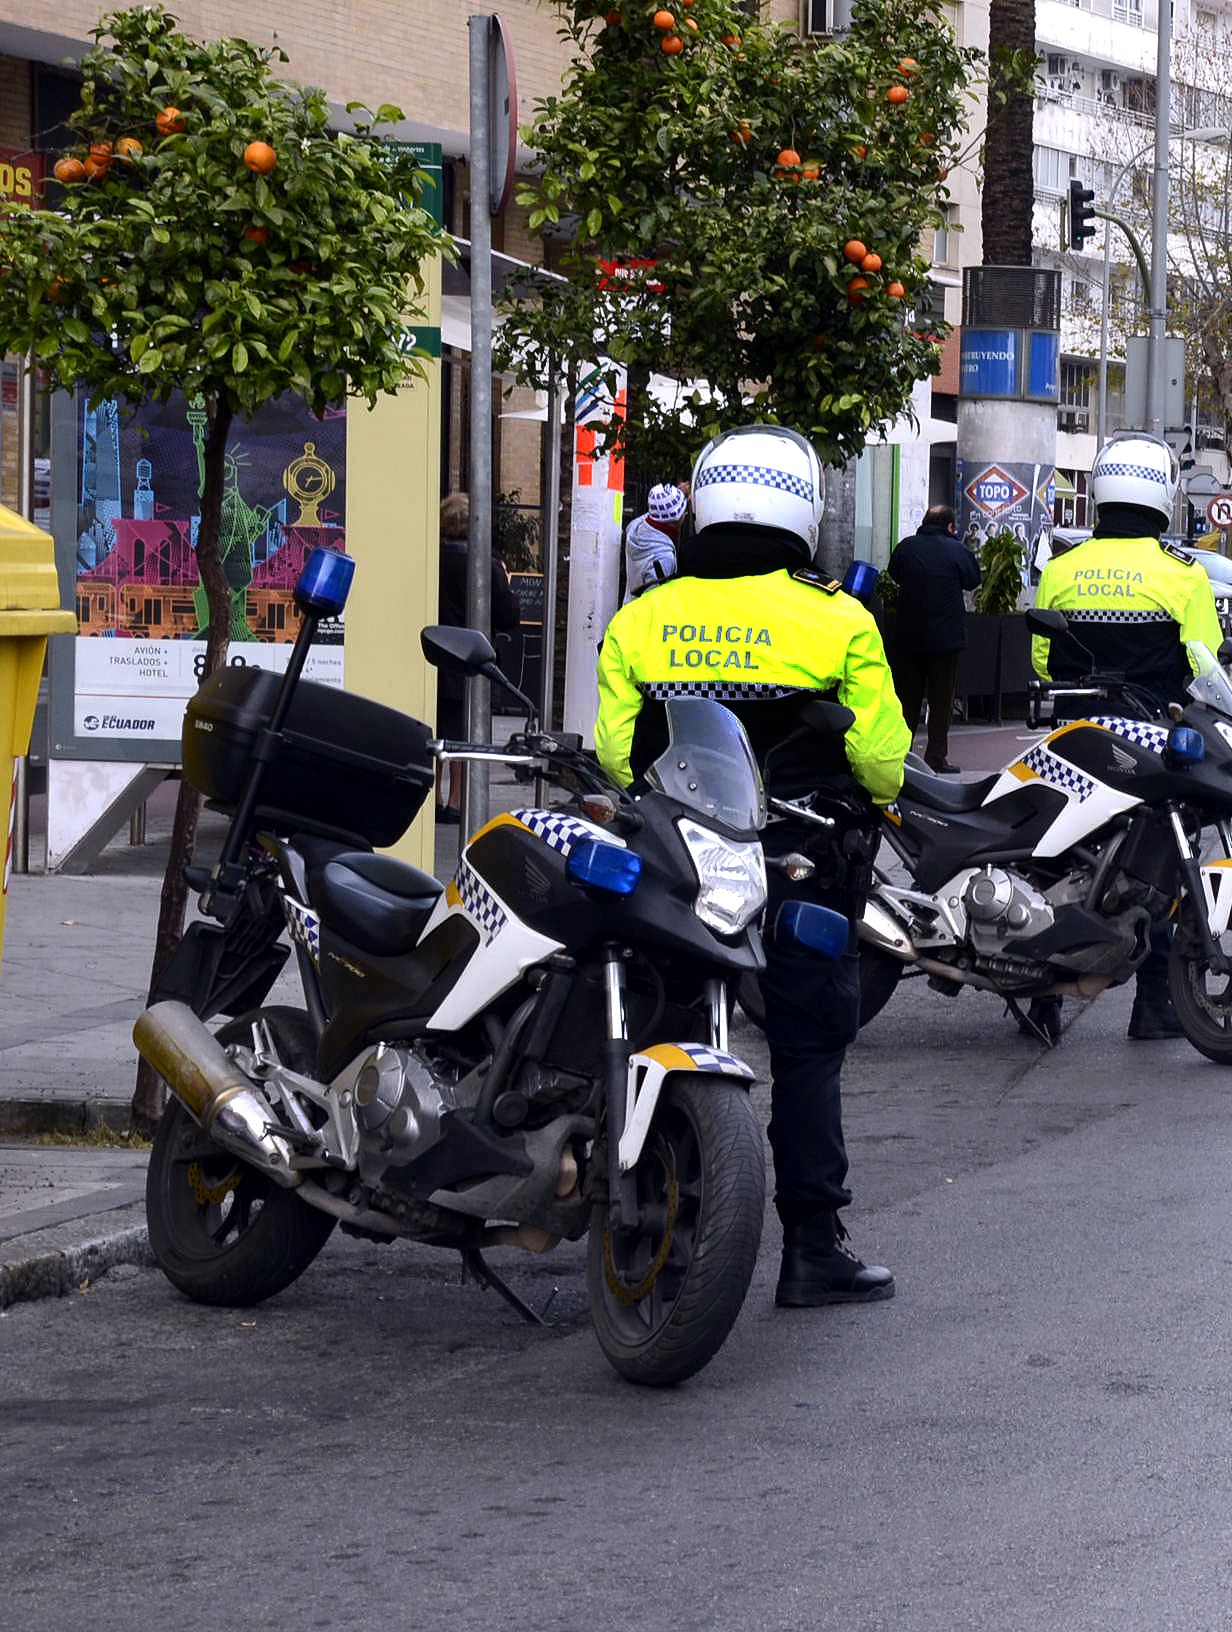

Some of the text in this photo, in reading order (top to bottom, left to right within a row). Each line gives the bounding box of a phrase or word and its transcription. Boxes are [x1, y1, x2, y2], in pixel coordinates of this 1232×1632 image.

[979, 485, 1011, 500] TOPO
[1077, 583, 1136, 597] LOCAL
[109, 657, 161, 666] TRASLADOS
[669, 648, 760, 669] LOCAL
[139, 669, 169, 678] HOTEL
[101, 718, 156, 730] ECUADOR
